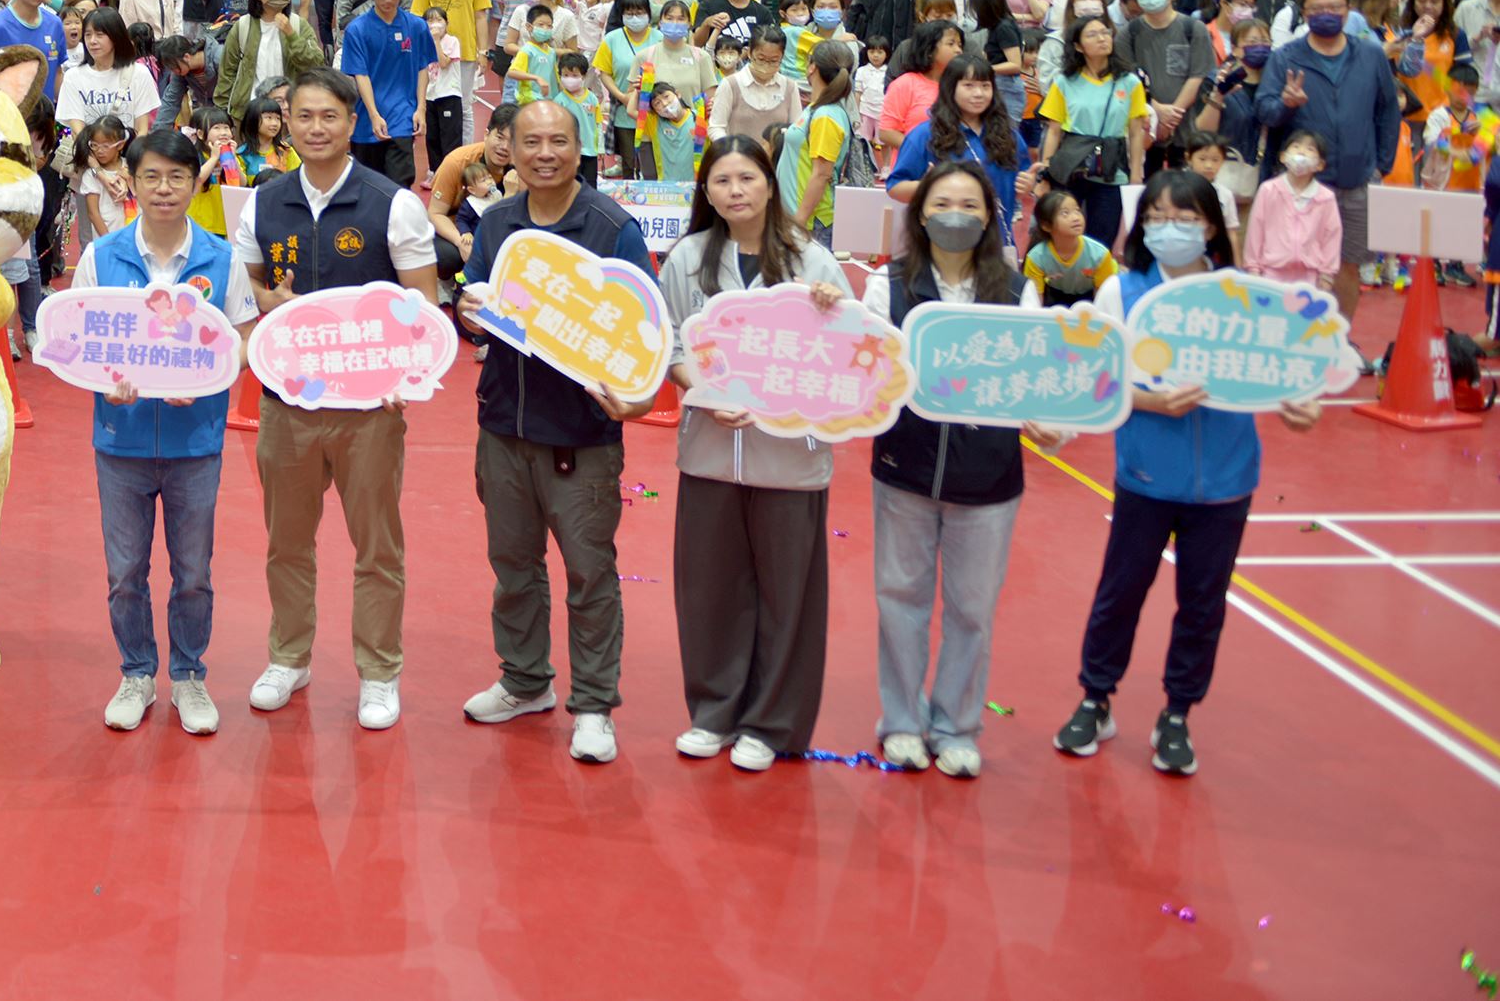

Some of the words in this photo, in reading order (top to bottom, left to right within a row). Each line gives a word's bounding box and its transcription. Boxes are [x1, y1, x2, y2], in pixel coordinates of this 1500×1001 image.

[639, 216, 680, 239] 幼兒園
[520, 256, 624, 333] 愛在一起
[83, 310, 138, 339] 陪伴
[271, 319, 385, 349] 愛在行動裡
[707, 324, 835, 367] 一起長大
[1151, 302, 1289, 349] 愛的力量
[82, 341, 216, 370] 是最好的禮物
[299, 343, 434, 375] 幸福在記憶裡
[931, 325, 1049, 371] 以愛為盾
[1176, 344, 1316, 390] 由我點亮
[731, 364, 861, 407] 一起幸福
